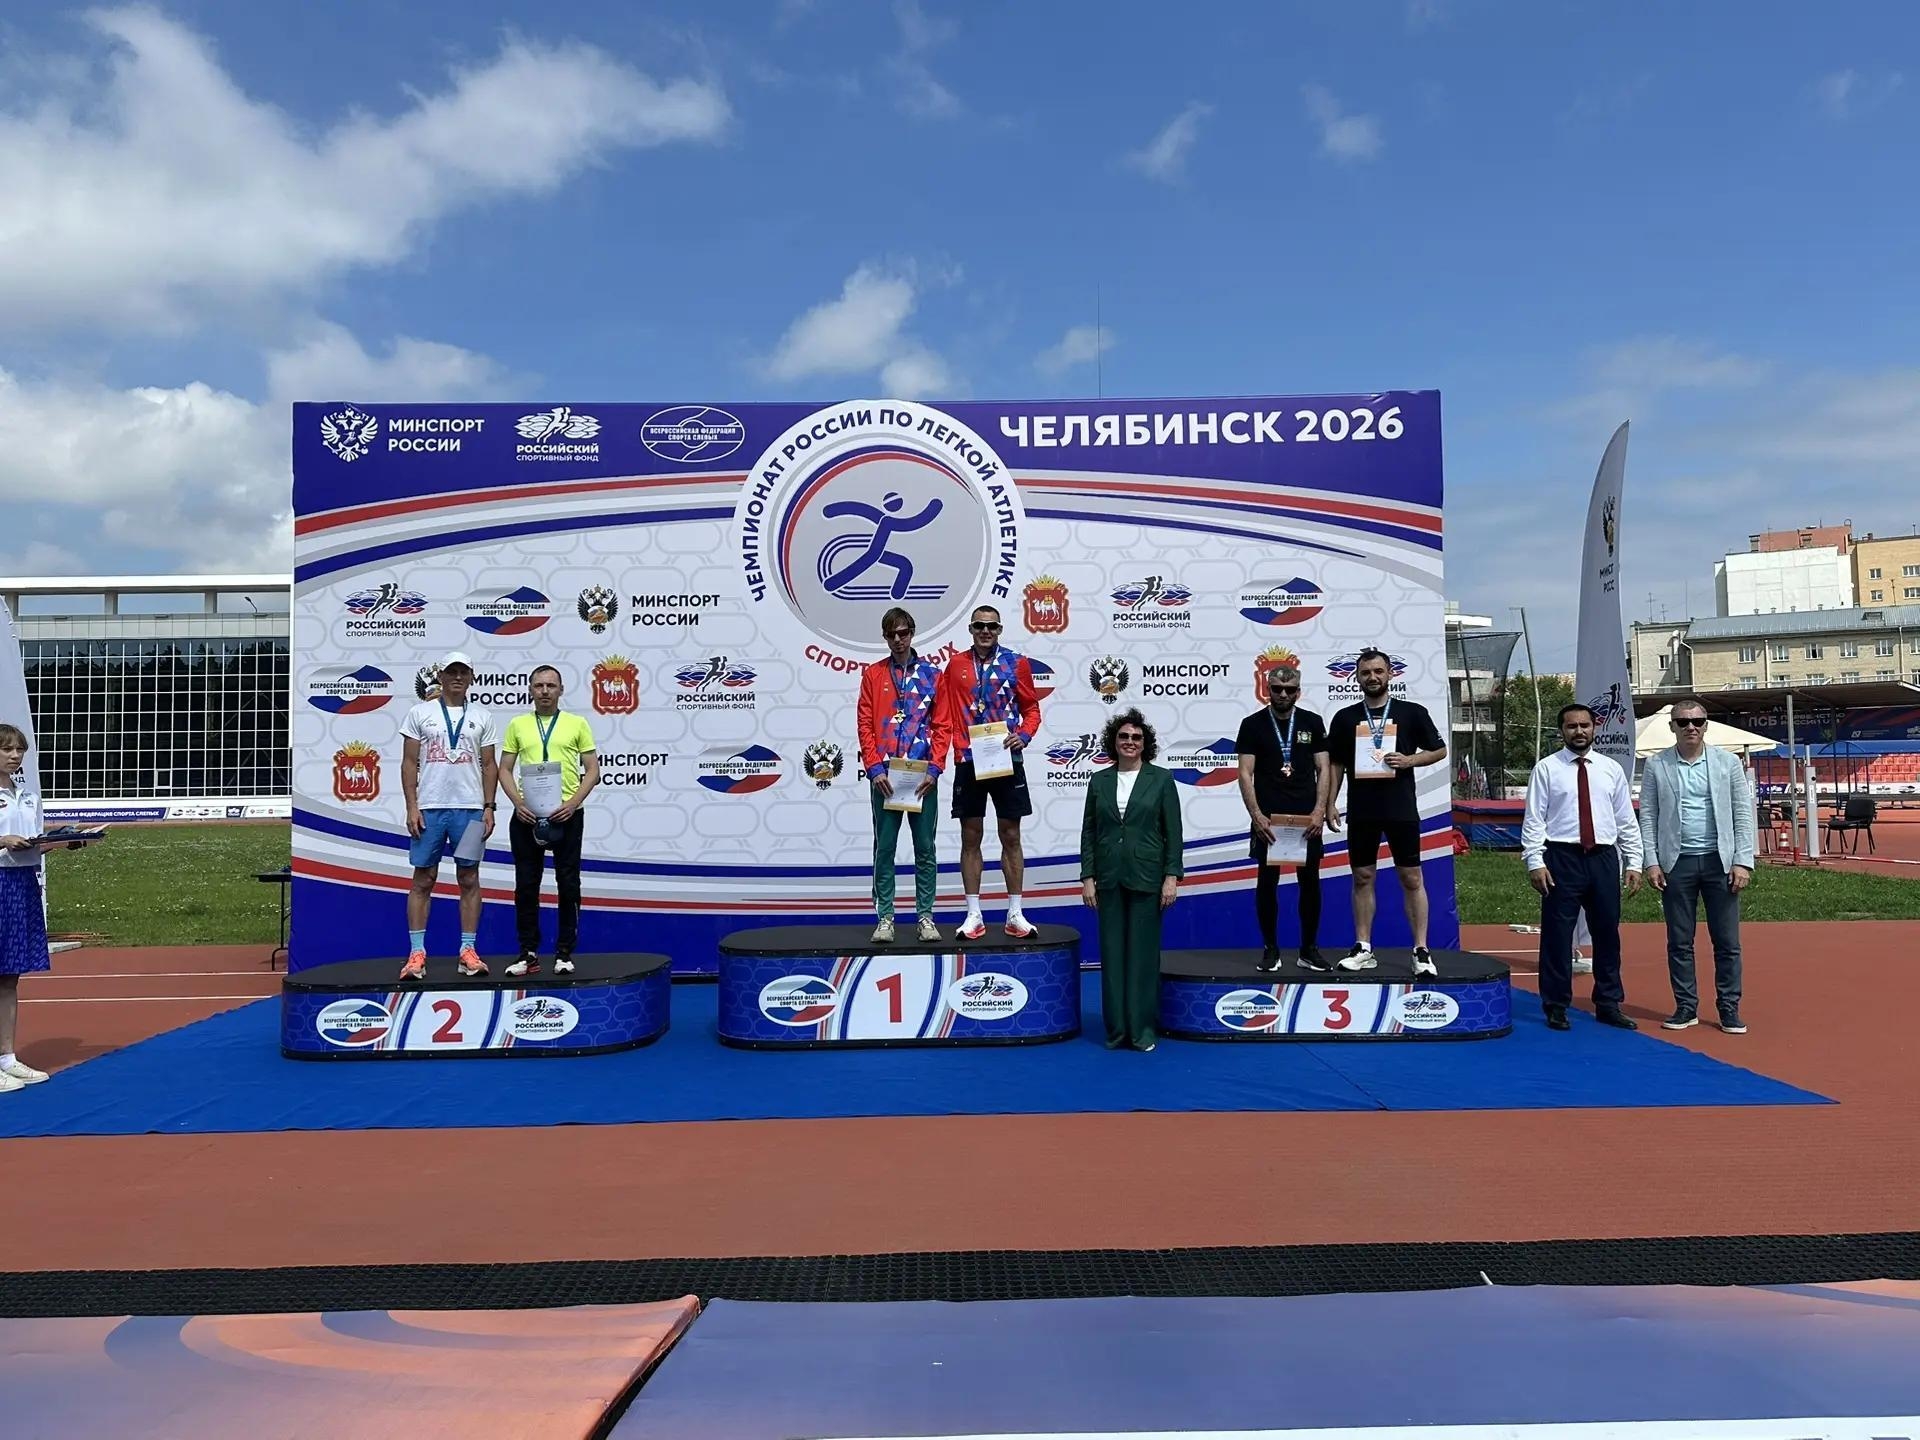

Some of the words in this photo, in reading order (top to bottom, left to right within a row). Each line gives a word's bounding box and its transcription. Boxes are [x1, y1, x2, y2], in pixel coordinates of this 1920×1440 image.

[388, 419, 485, 432] МИНСПОРТ
[1000, 411, 1285, 447] ЧЕЛЯБИНСК
[1294, 406, 1404, 443] 2026
[388, 438, 461, 452] РОССИИ
[516, 443, 599, 454] РОССИЙСКИЙ
[516, 454, 573, 462] СПОРТИВНЫЙ
[574, 454, 599, 462] ФОНД
[742, 457, 785, 602] ЧЕМПИОНАТ
[781, 409, 872, 461] РОССИИ
[879, 409, 912, 427] ПО
[917, 417, 999, 482] ЛЕГКОЙ
[987, 485, 1017, 599] АТЛЕТИКЕ
[632, 594, 720, 608] МИНСПОРТ
[632, 613, 699, 626] РОССИИ
[1113, 610, 1191, 621] РОССИЙСКИЙ
[346, 619, 426, 629] РОССИЙСКИЙ
[401, 630, 426, 638] ФОНД
[1142, 664, 1230, 678] МИНСПОРТ
[471, 674, 528, 686] МИНСП
[1143, 683, 1208, 696] РОССИИ
[676, 691, 755, 702] РОССИЙСКИЙ
[1047, 769, 1093, 780] РОССИЙ
[875, 972, 902, 1023] 1
[962, 999, 1013, 1007] РОССИЙСКИЙ
[1322, 990, 1350, 1030] 3
[431, 1000, 463, 1043] 2
